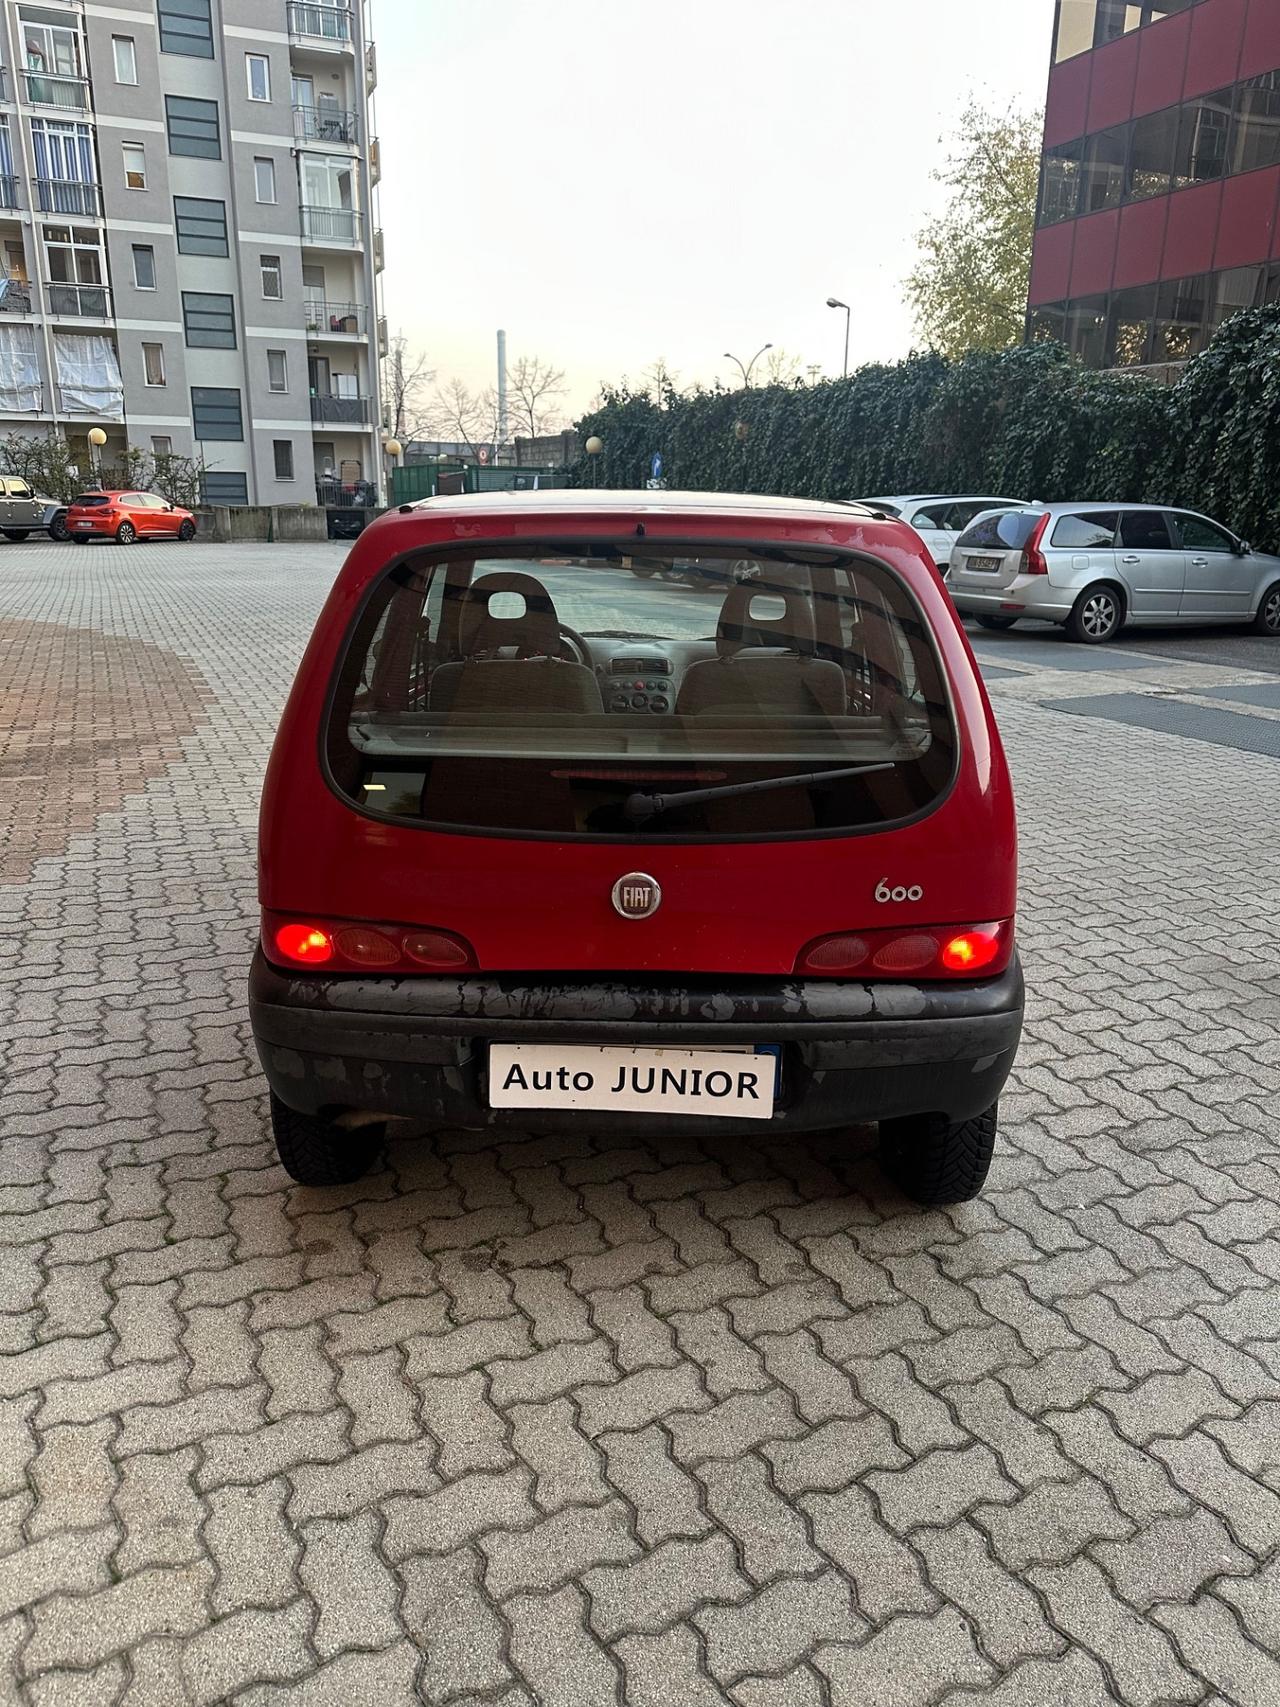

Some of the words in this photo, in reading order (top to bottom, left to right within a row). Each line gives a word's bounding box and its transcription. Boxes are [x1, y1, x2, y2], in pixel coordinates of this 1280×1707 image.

[623, 886, 651, 907] FIAT
[875, 877, 923, 903] 600
[502, 1063, 594, 1091] Auto
[611, 1066, 760, 1099] JUNIOR
